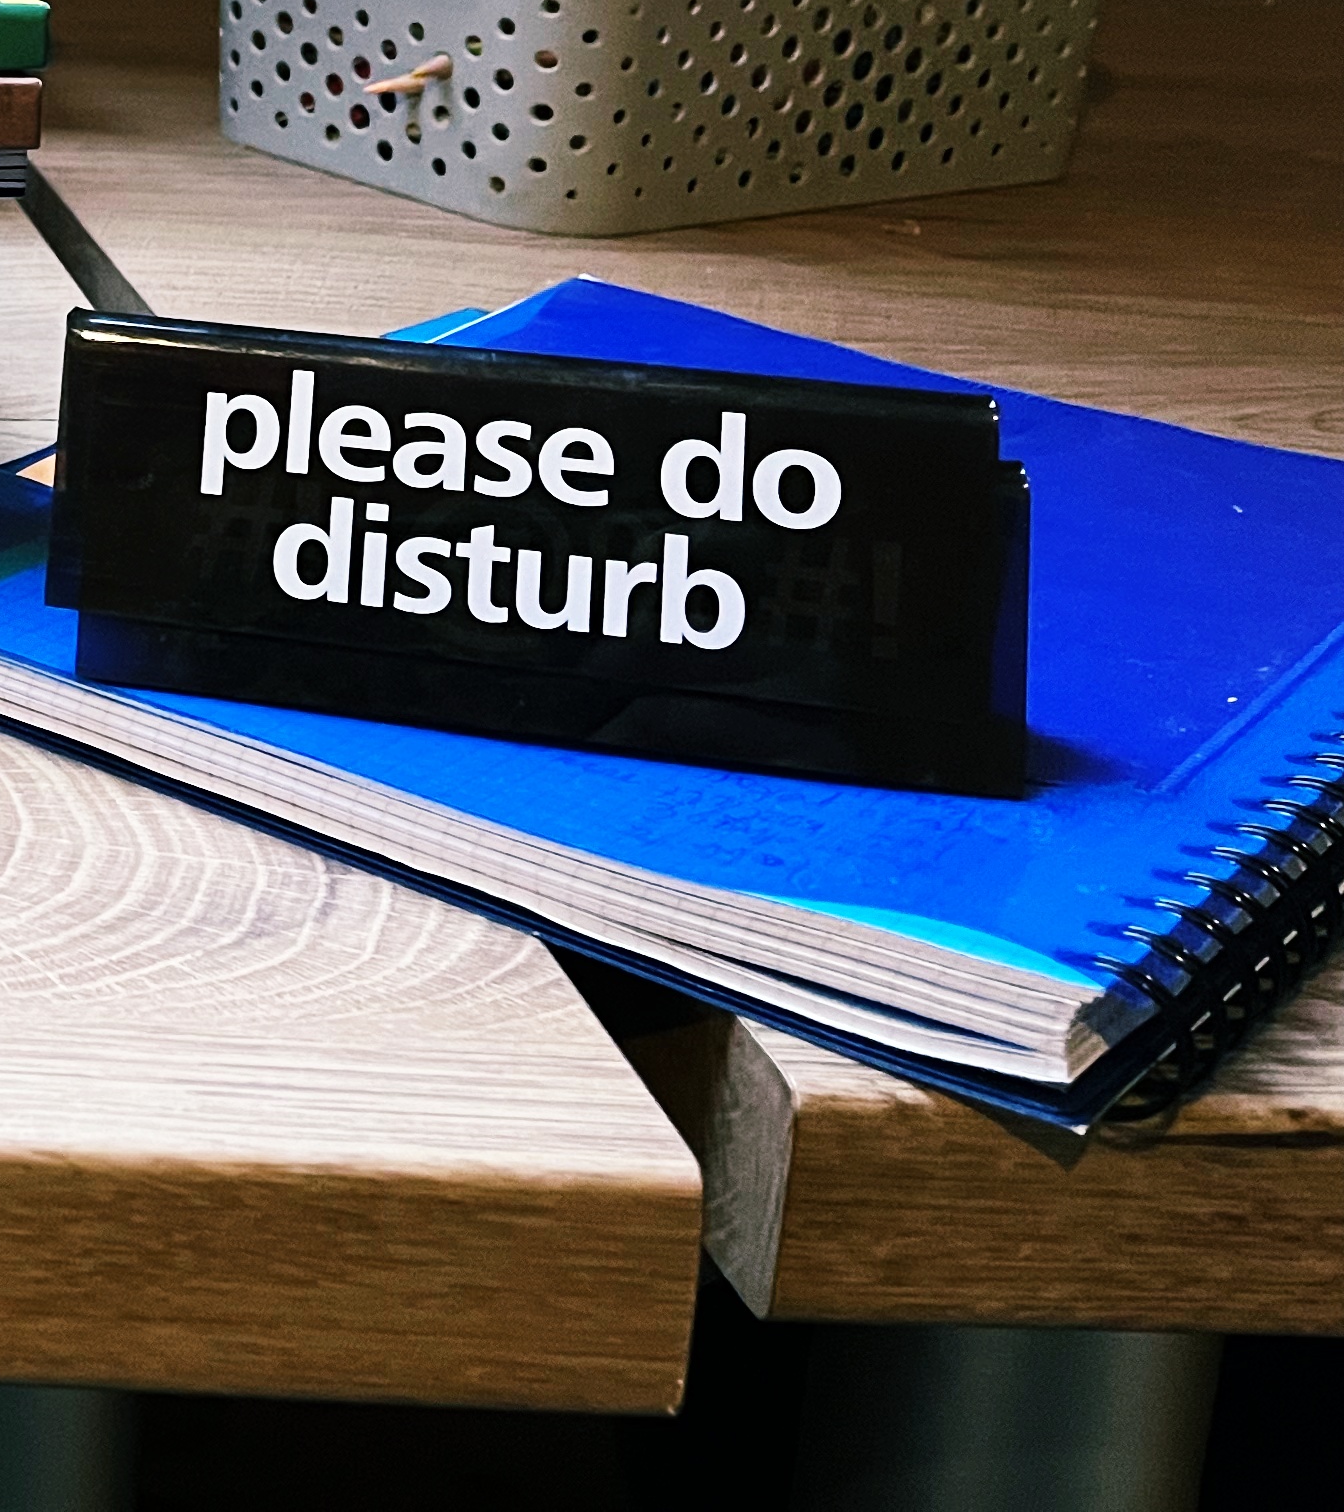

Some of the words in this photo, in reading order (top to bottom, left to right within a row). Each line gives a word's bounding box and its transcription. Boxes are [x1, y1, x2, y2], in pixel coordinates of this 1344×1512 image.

[200, 369, 616, 507] please
[660, 411, 842, 530] do
[272, 496, 746, 650] disturb
